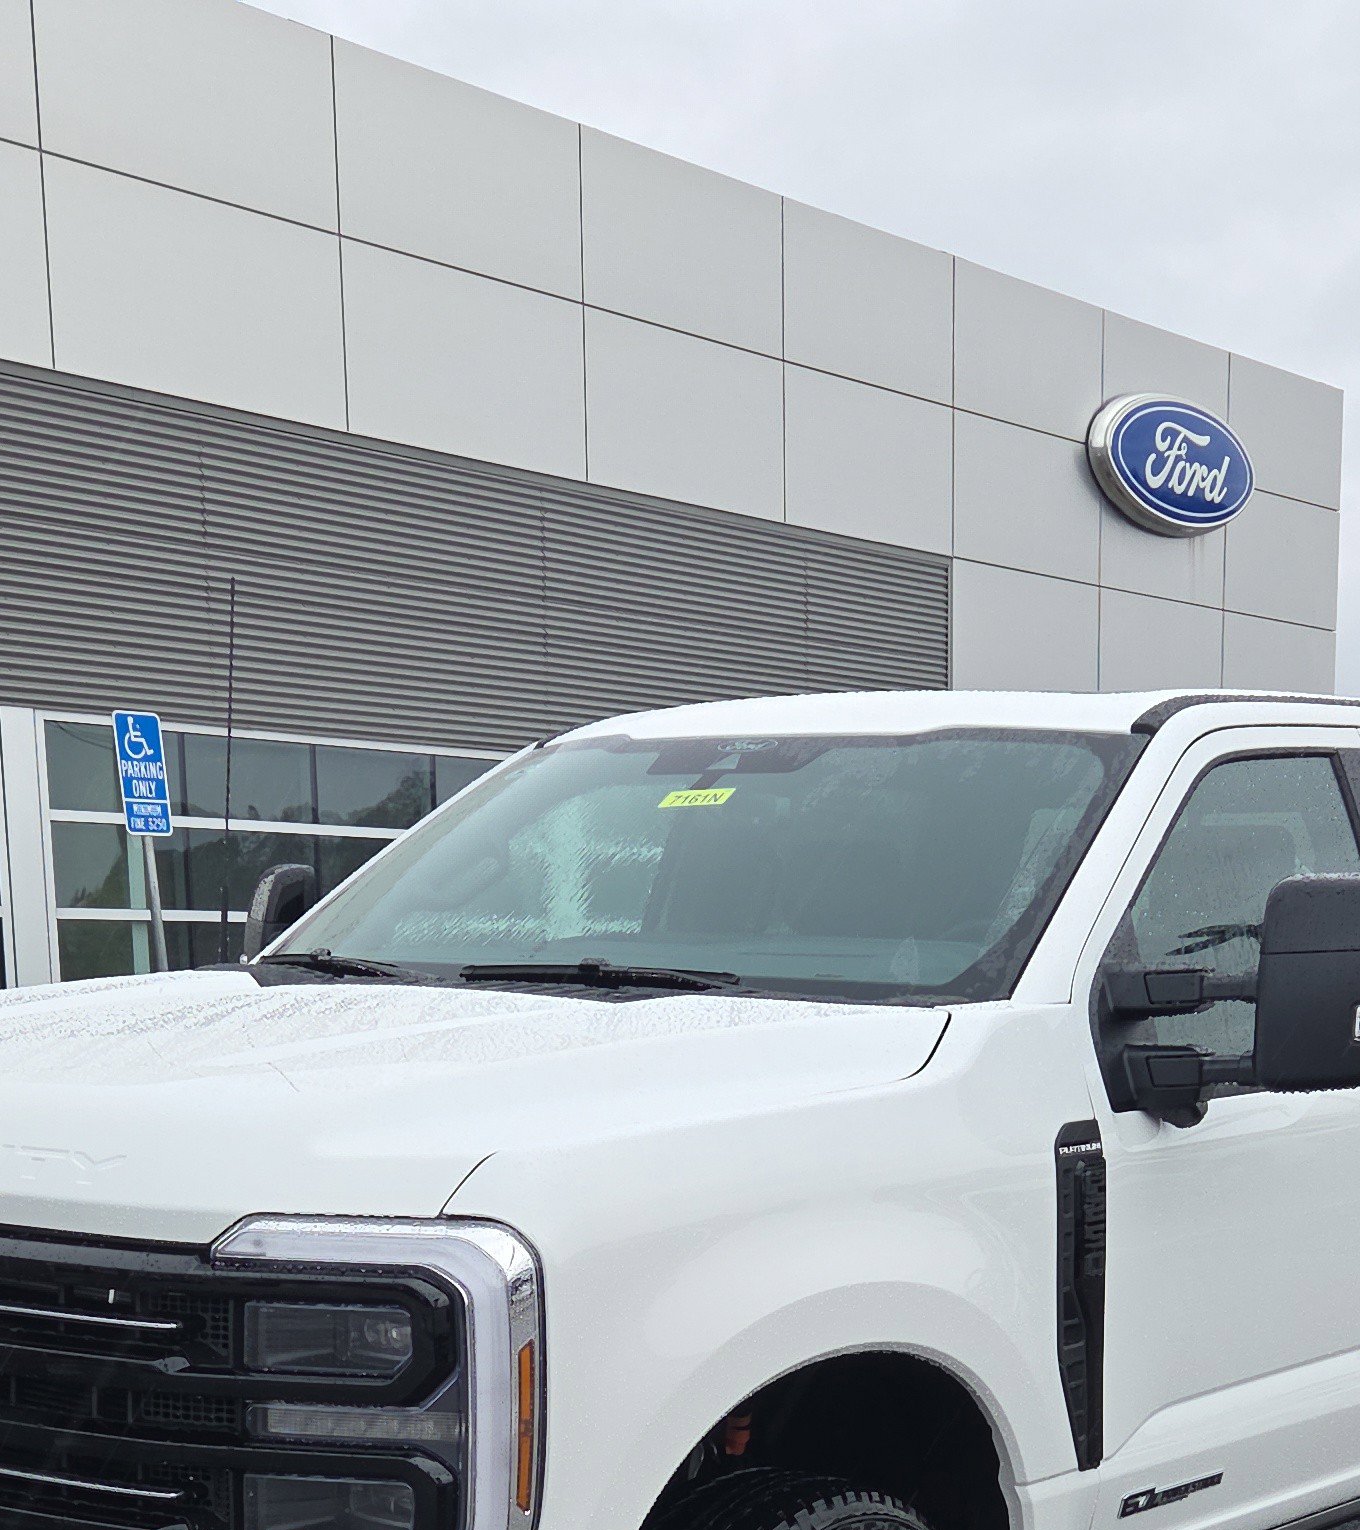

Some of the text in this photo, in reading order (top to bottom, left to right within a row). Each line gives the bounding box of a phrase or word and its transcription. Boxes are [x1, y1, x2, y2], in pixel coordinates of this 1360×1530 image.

[1145, 421, 1231, 504] Ford
[121, 760, 164, 780] PARKING
[132, 780, 156, 798] ONLY
[669, 793, 725, 806] 7161N
[130, 817, 146, 830] FINE
